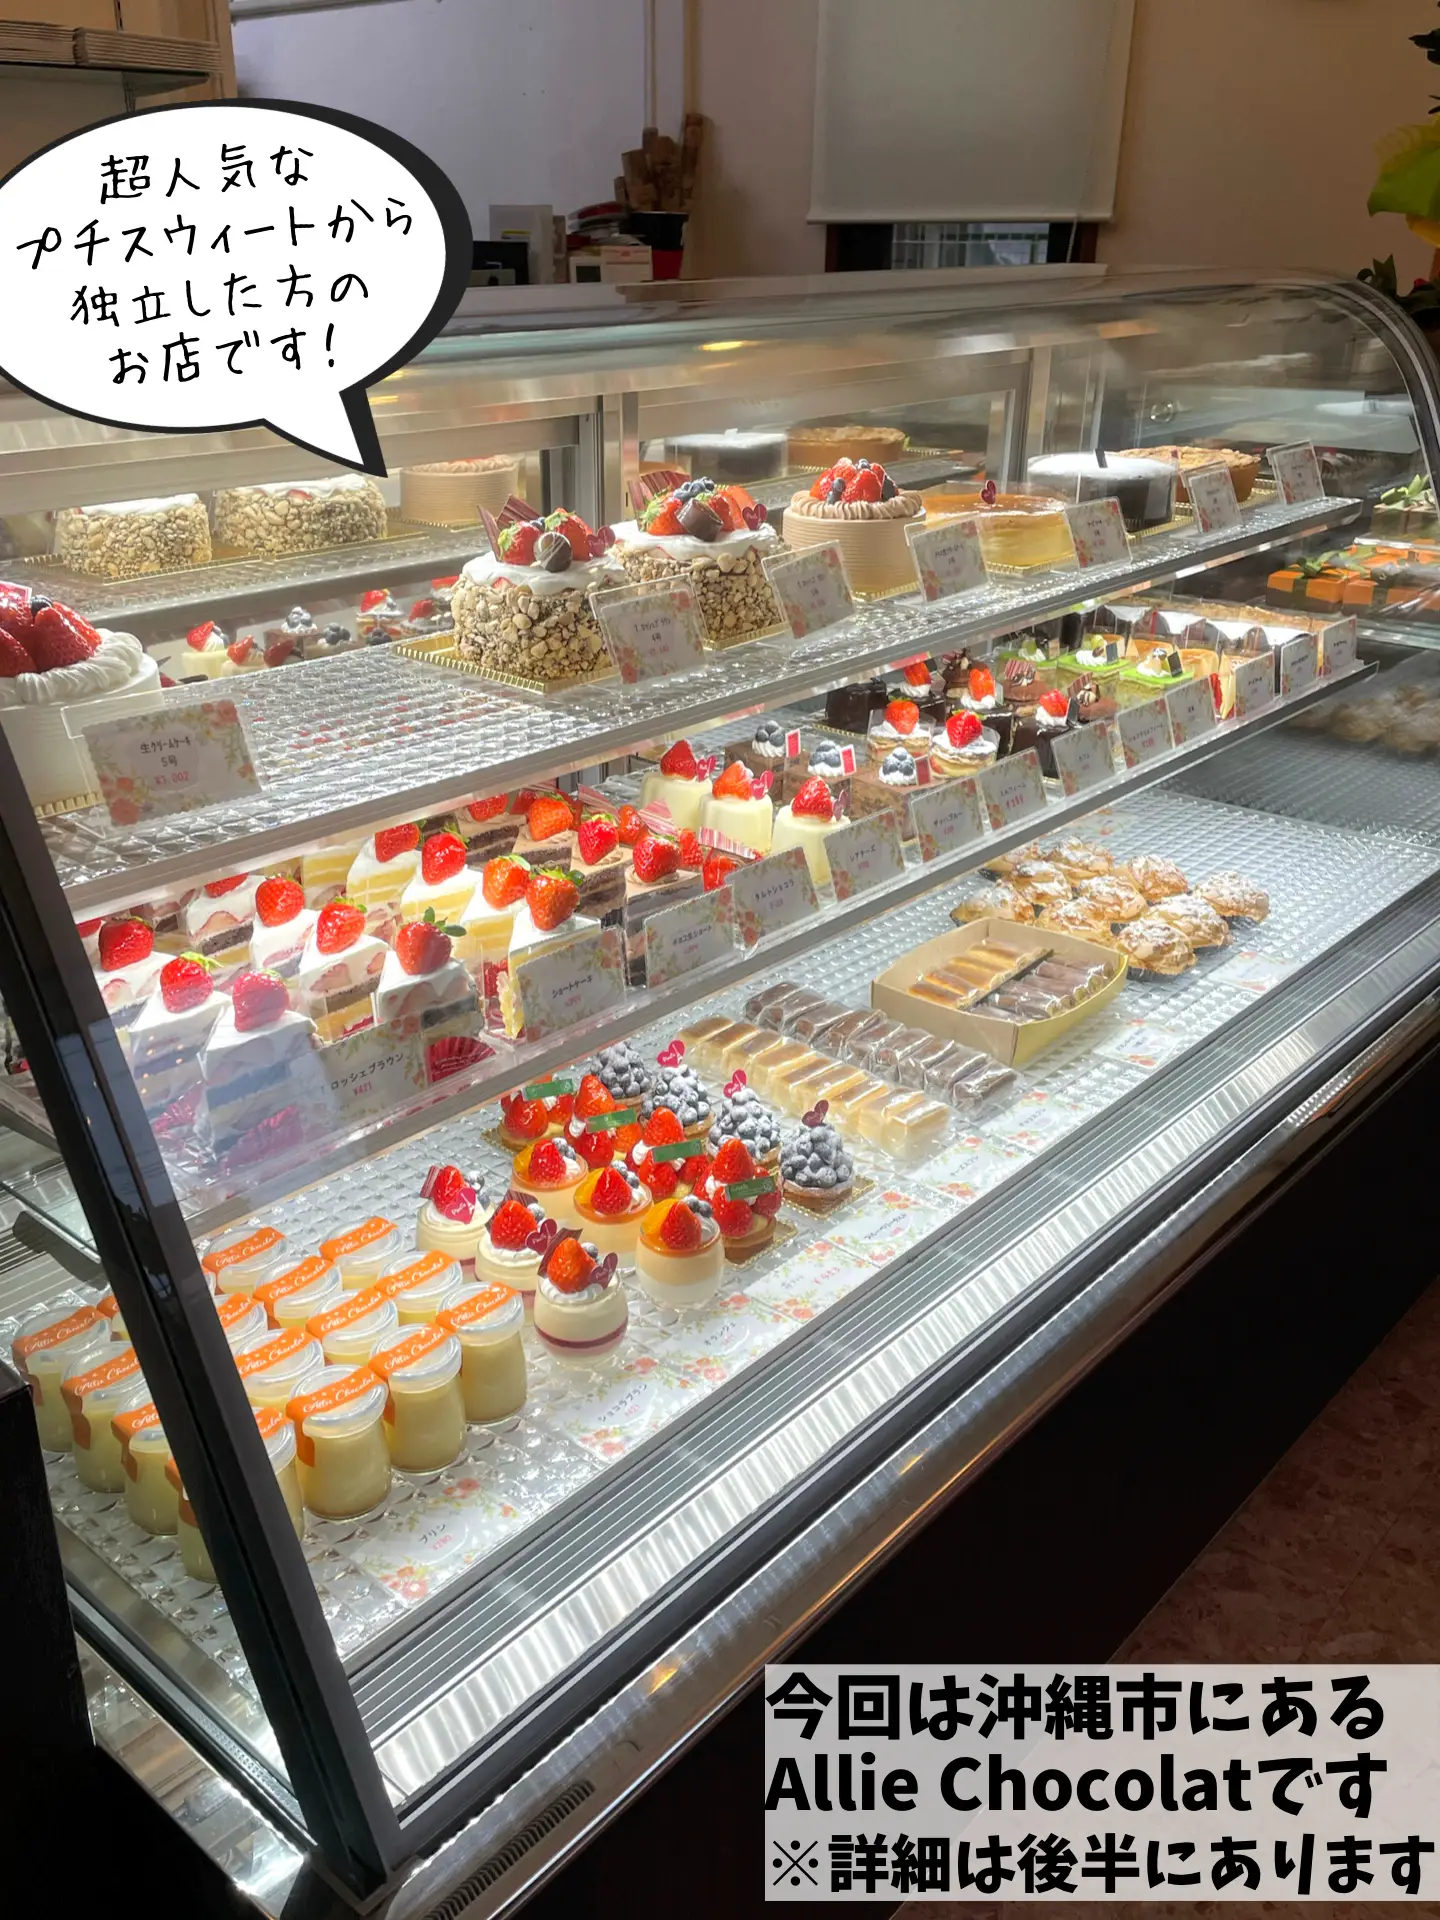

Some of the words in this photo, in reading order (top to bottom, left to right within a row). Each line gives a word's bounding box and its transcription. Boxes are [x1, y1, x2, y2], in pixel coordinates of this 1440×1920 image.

[161, 755, 177, 768] 5号
[552, 974, 593, 999] ショートケーキ
[597, 1383, 647, 1422] ショコラブラン
[418, 1523, 446, 1544] プリン
